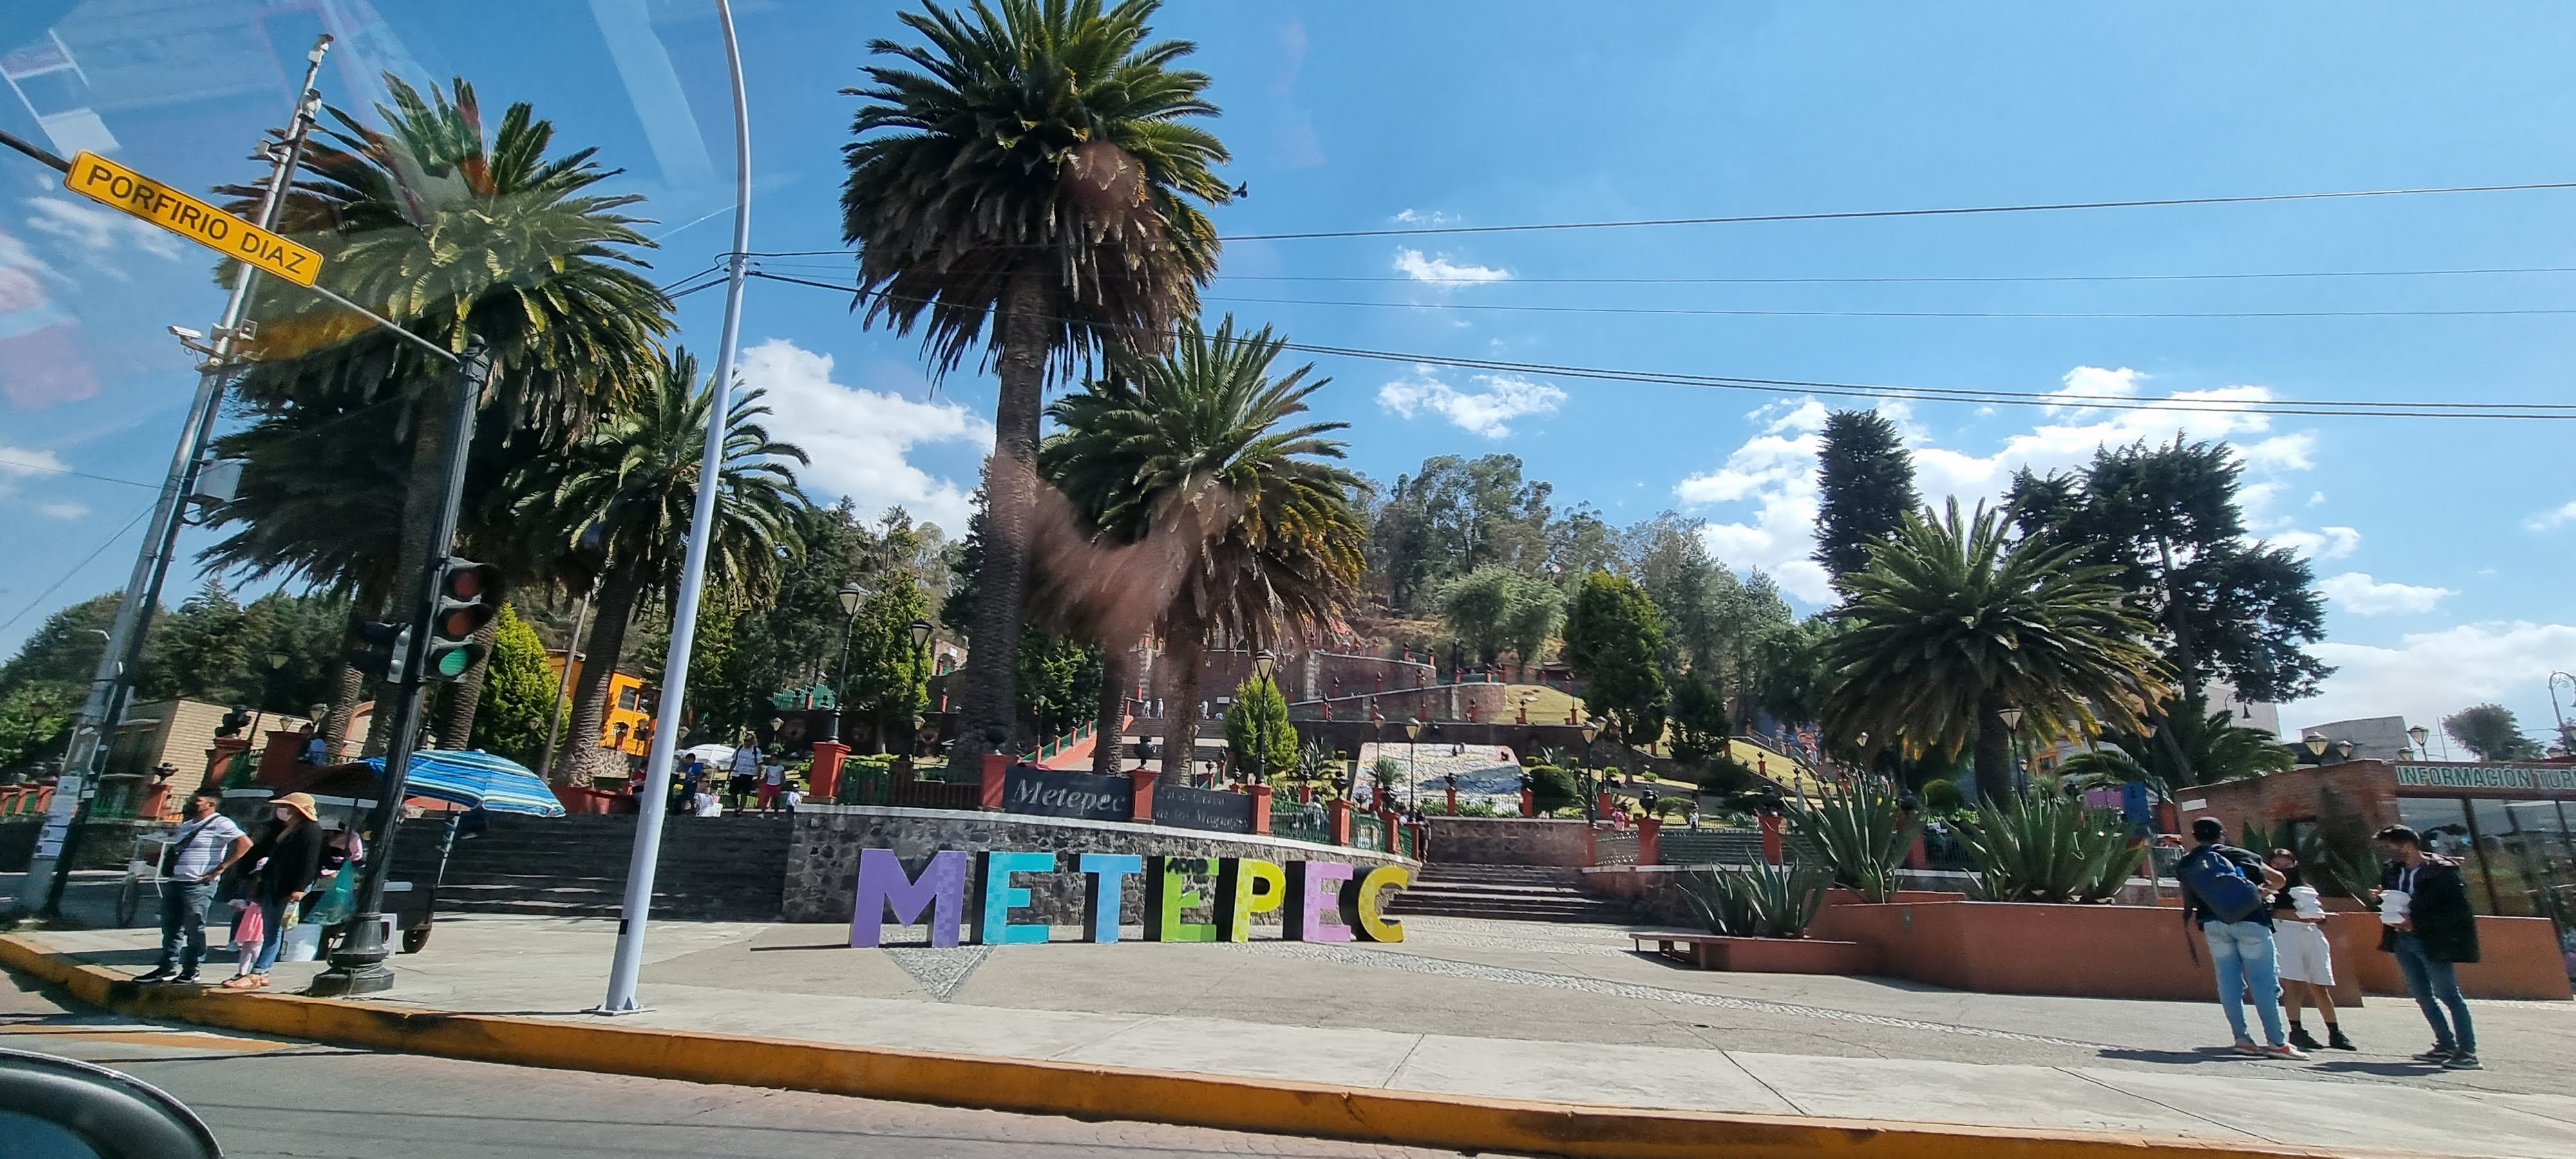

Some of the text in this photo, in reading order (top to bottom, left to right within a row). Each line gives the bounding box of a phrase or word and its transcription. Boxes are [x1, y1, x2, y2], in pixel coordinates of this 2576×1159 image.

[86, 164, 307, 275] PORFIRIO DIAZ
[1014, 778, 1126, 816] Metepec
[2395, 764, 2533, 789] INFORMACIÓN
[849, 847, 1409, 948] METEPEC
